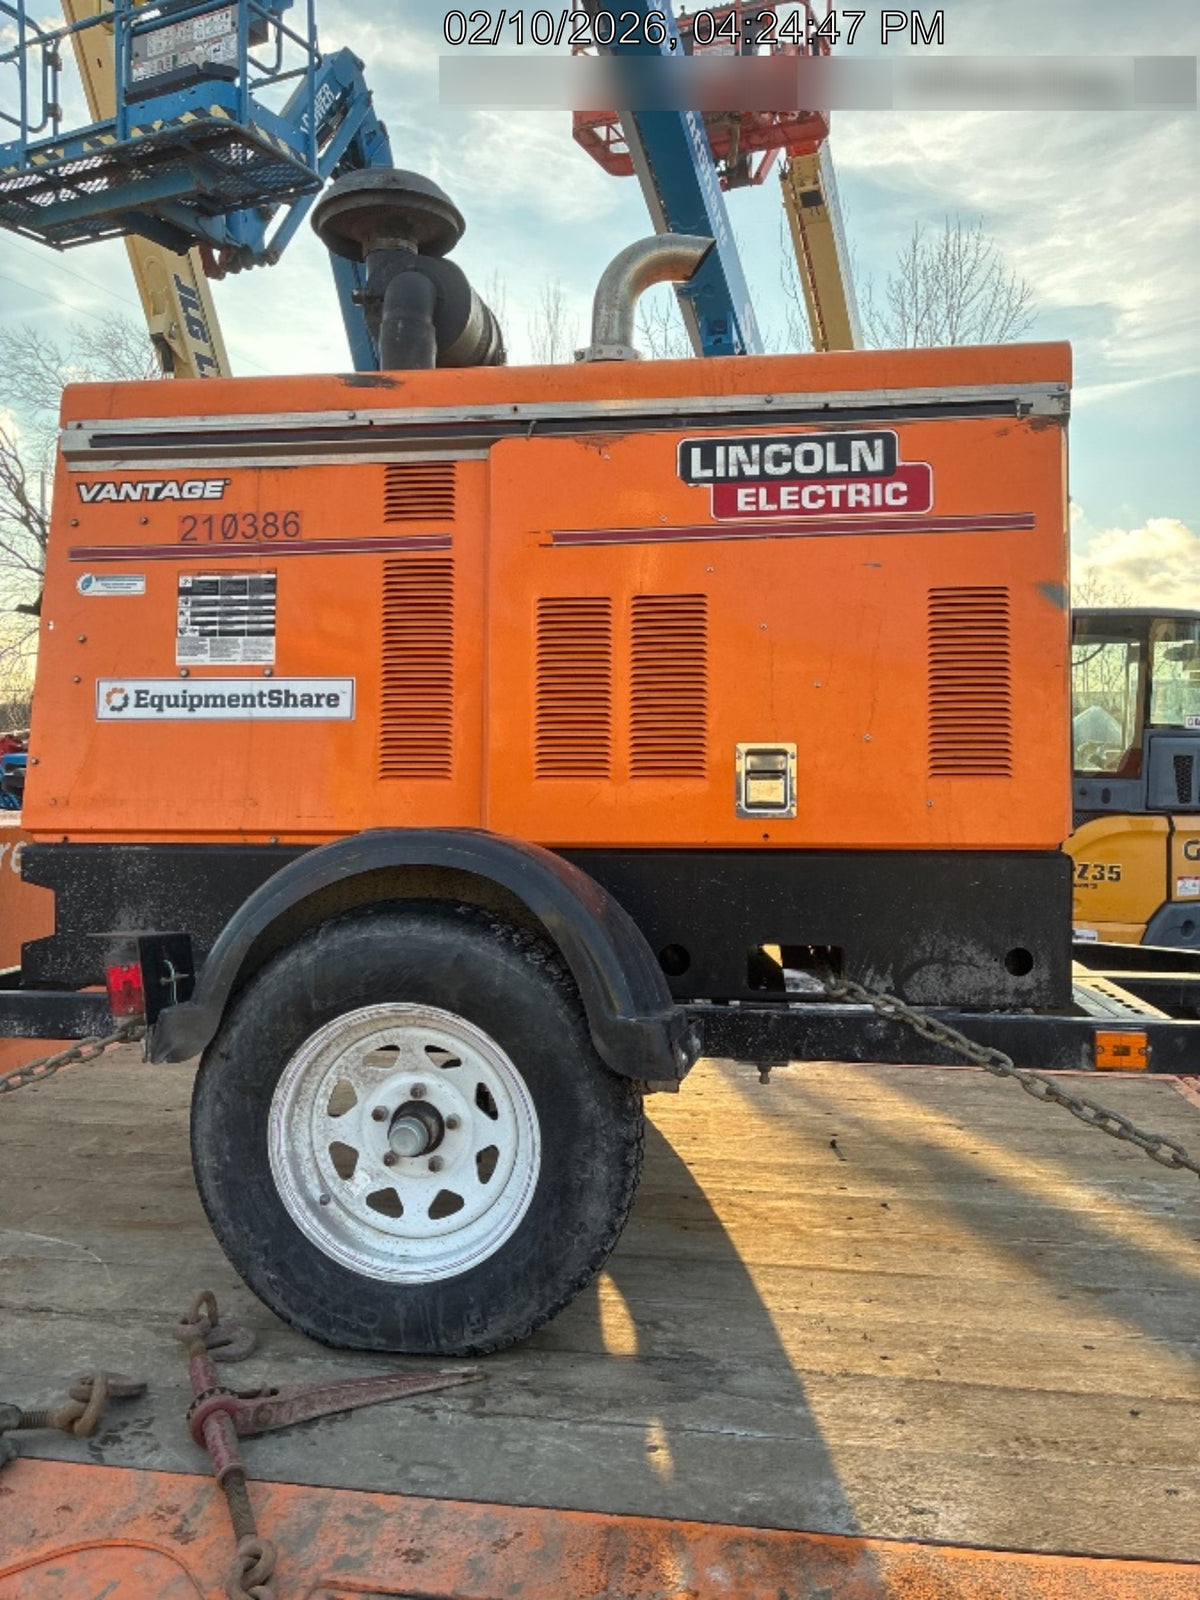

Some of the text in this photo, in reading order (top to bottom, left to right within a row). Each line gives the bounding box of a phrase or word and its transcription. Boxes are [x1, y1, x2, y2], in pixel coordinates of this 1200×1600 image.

[173, 272, 217, 378] JLG L
[690, 438, 886, 480] LINCOLN
[77, 479, 229, 503] VANTAGE
[736, 481, 909, 512] ELECTRIC
[180, 510, 301, 542] 210386
[133, 688, 341, 712] EquipmentShare
